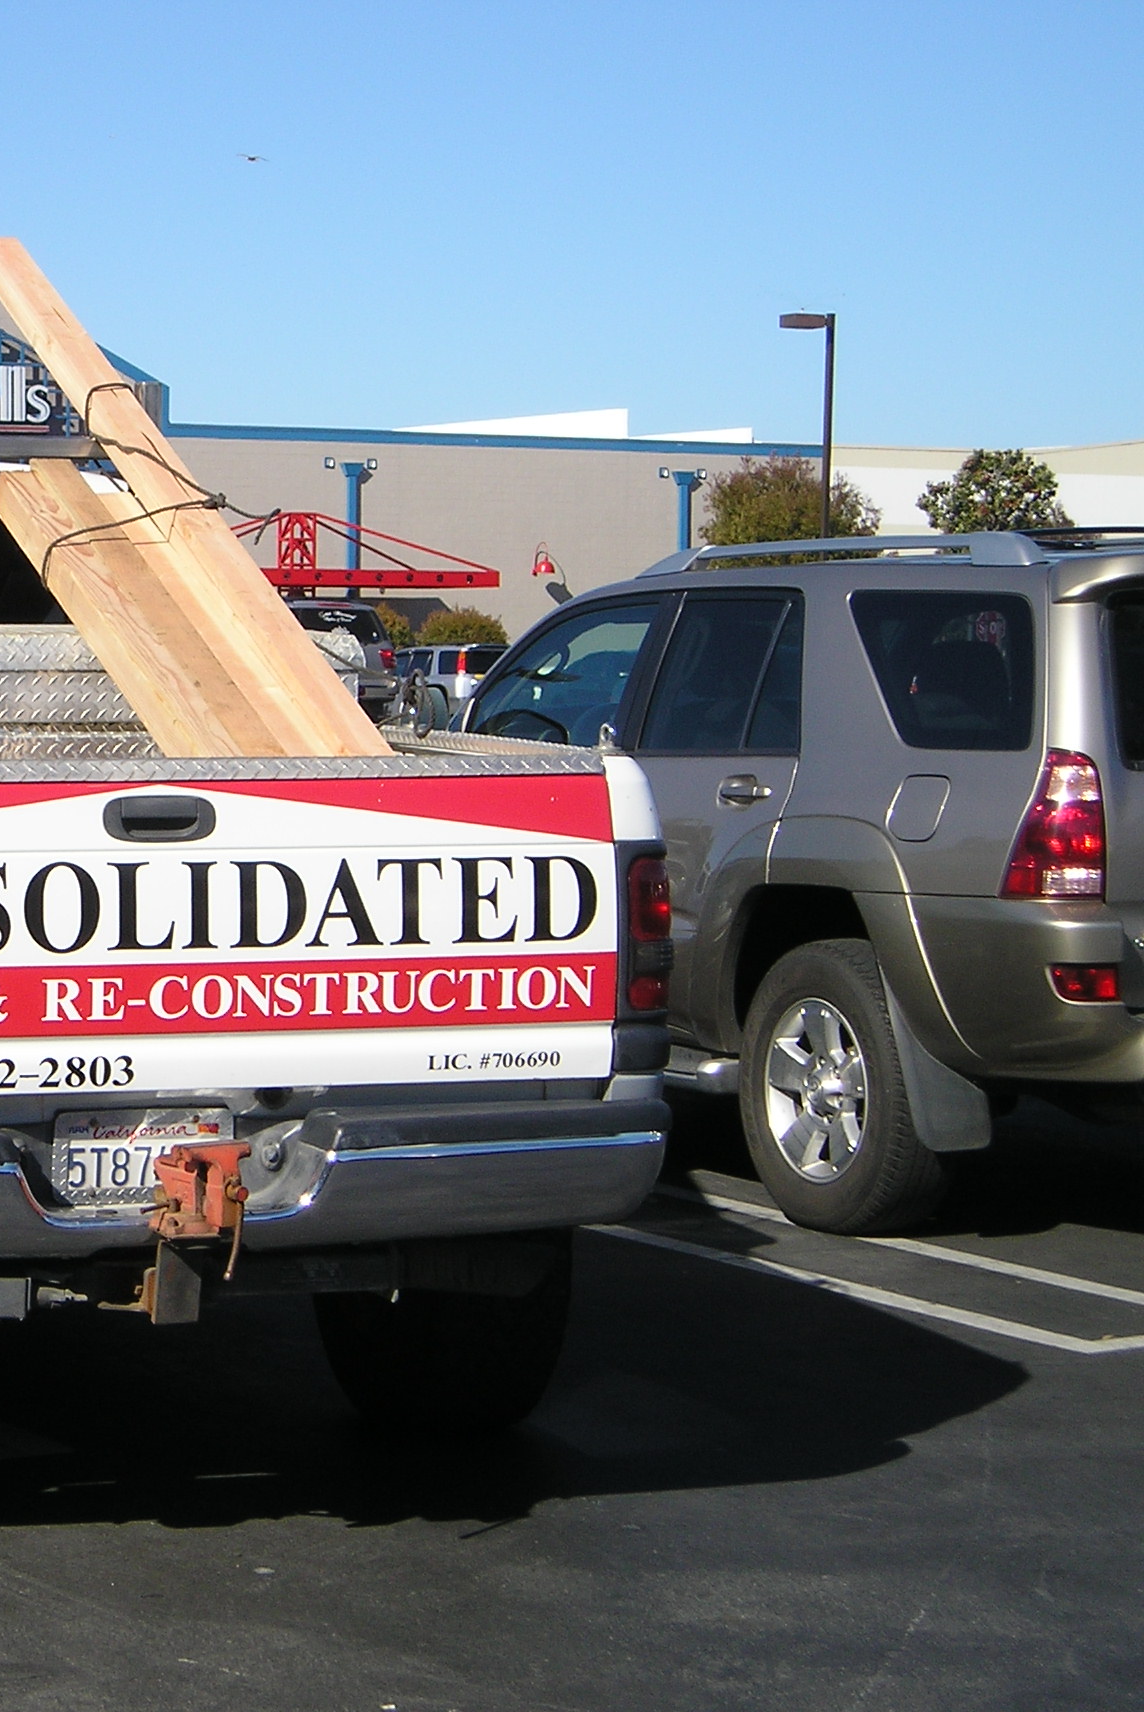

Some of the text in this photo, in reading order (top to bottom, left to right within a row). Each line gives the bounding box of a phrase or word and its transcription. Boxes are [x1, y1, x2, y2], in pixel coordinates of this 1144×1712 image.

[41, 964, 596, 1022] RE-CONSTRUCTION
[428, 1051, 561, 1070] LIC. #706690
[67, 1145, 169, 1188] 5T87
